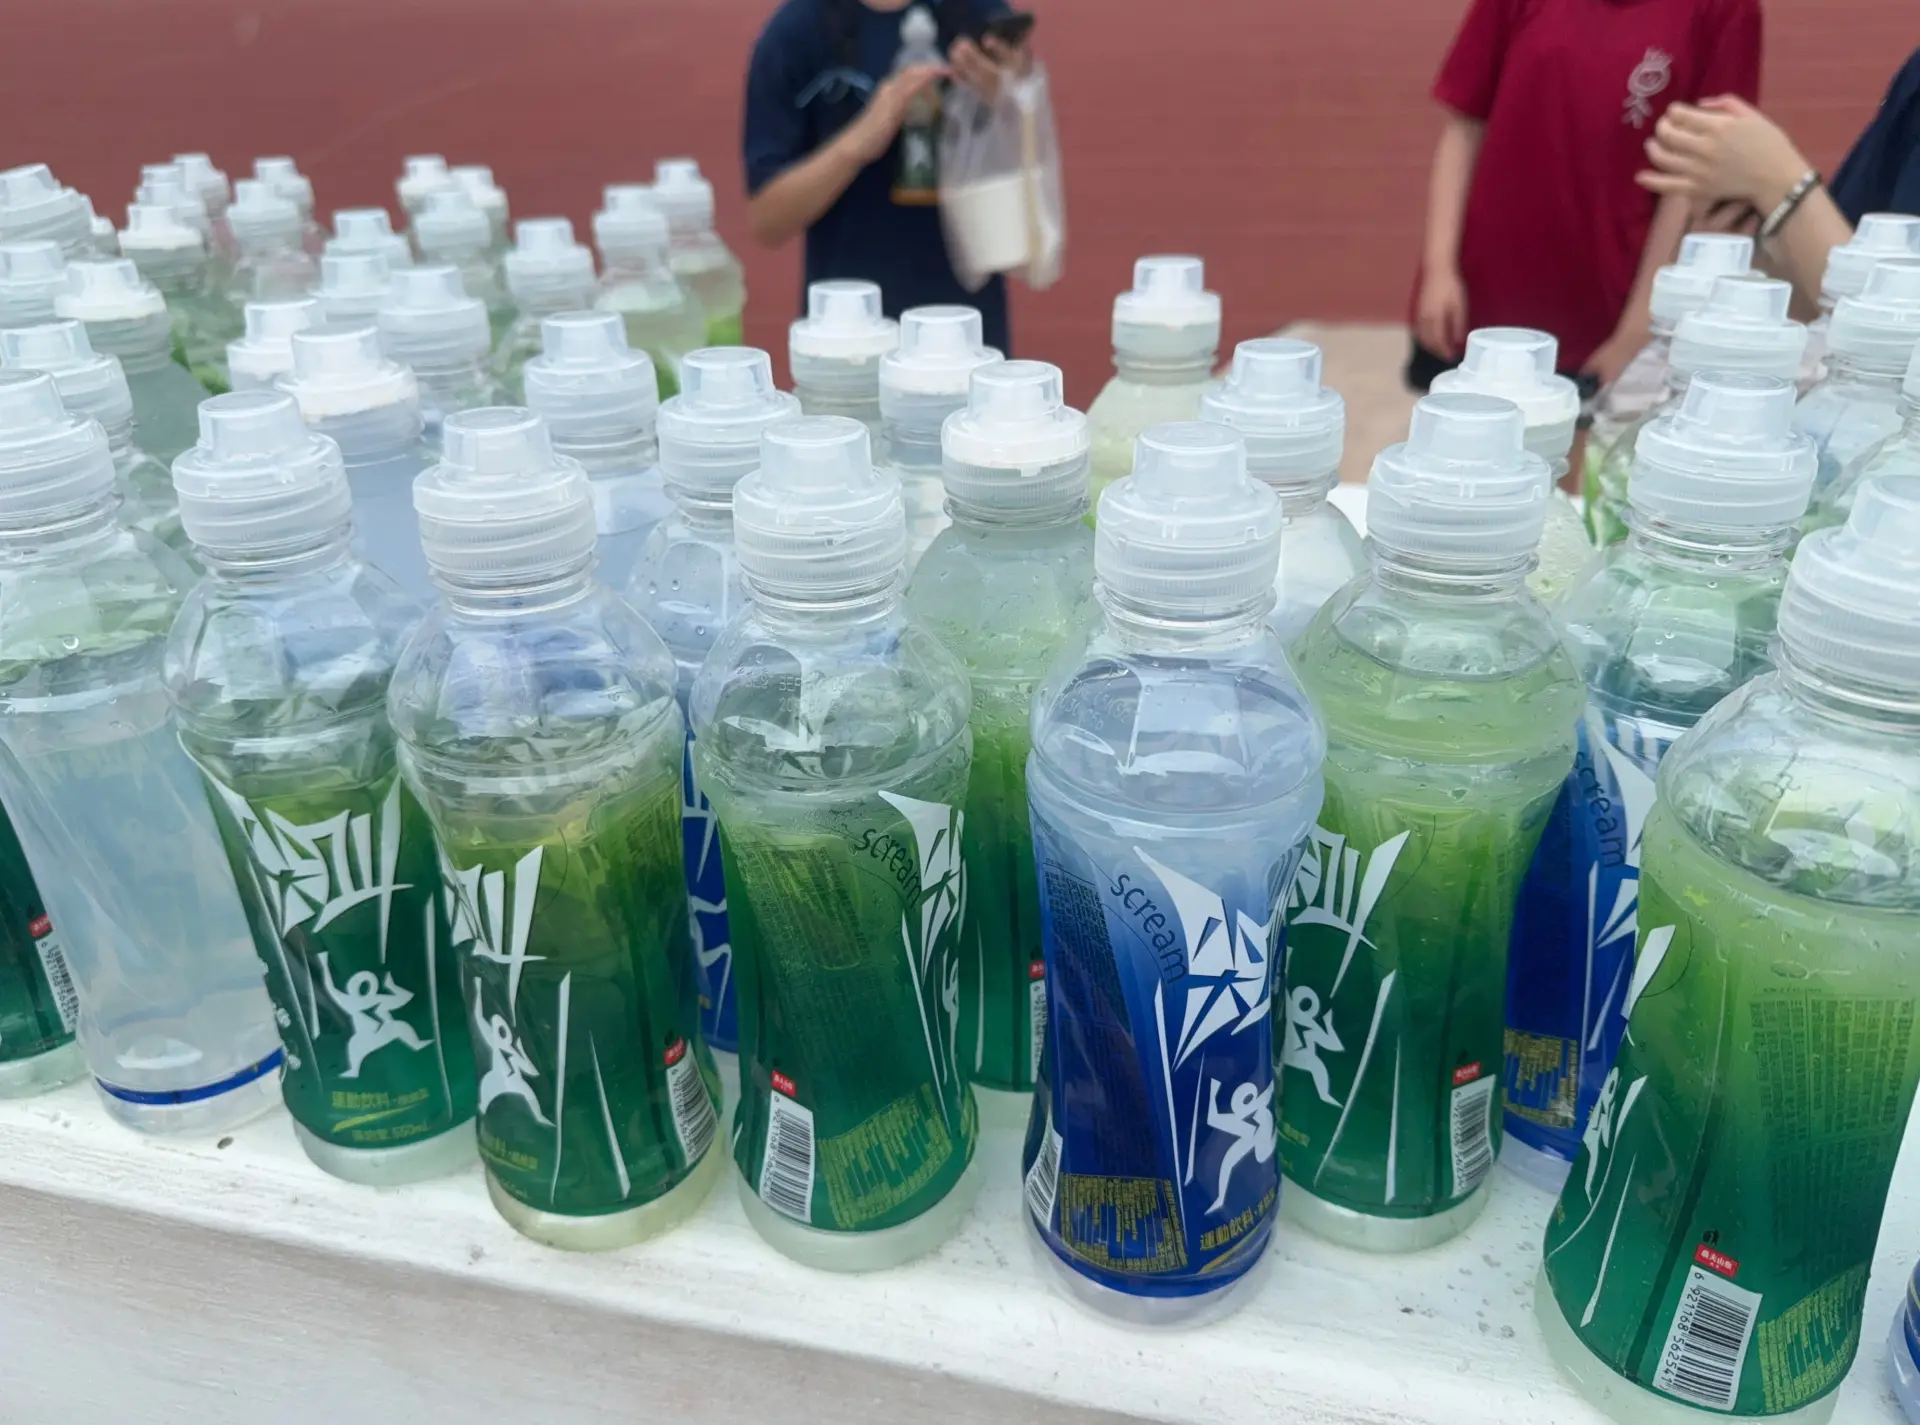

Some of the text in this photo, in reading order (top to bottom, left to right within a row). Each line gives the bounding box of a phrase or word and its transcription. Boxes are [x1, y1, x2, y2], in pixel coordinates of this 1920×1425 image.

[853, 827, 924, 910] scream
[1110, 873, 1189, 985] scream
[1661, 1271, 1705, 1385] 6 921168 562541
